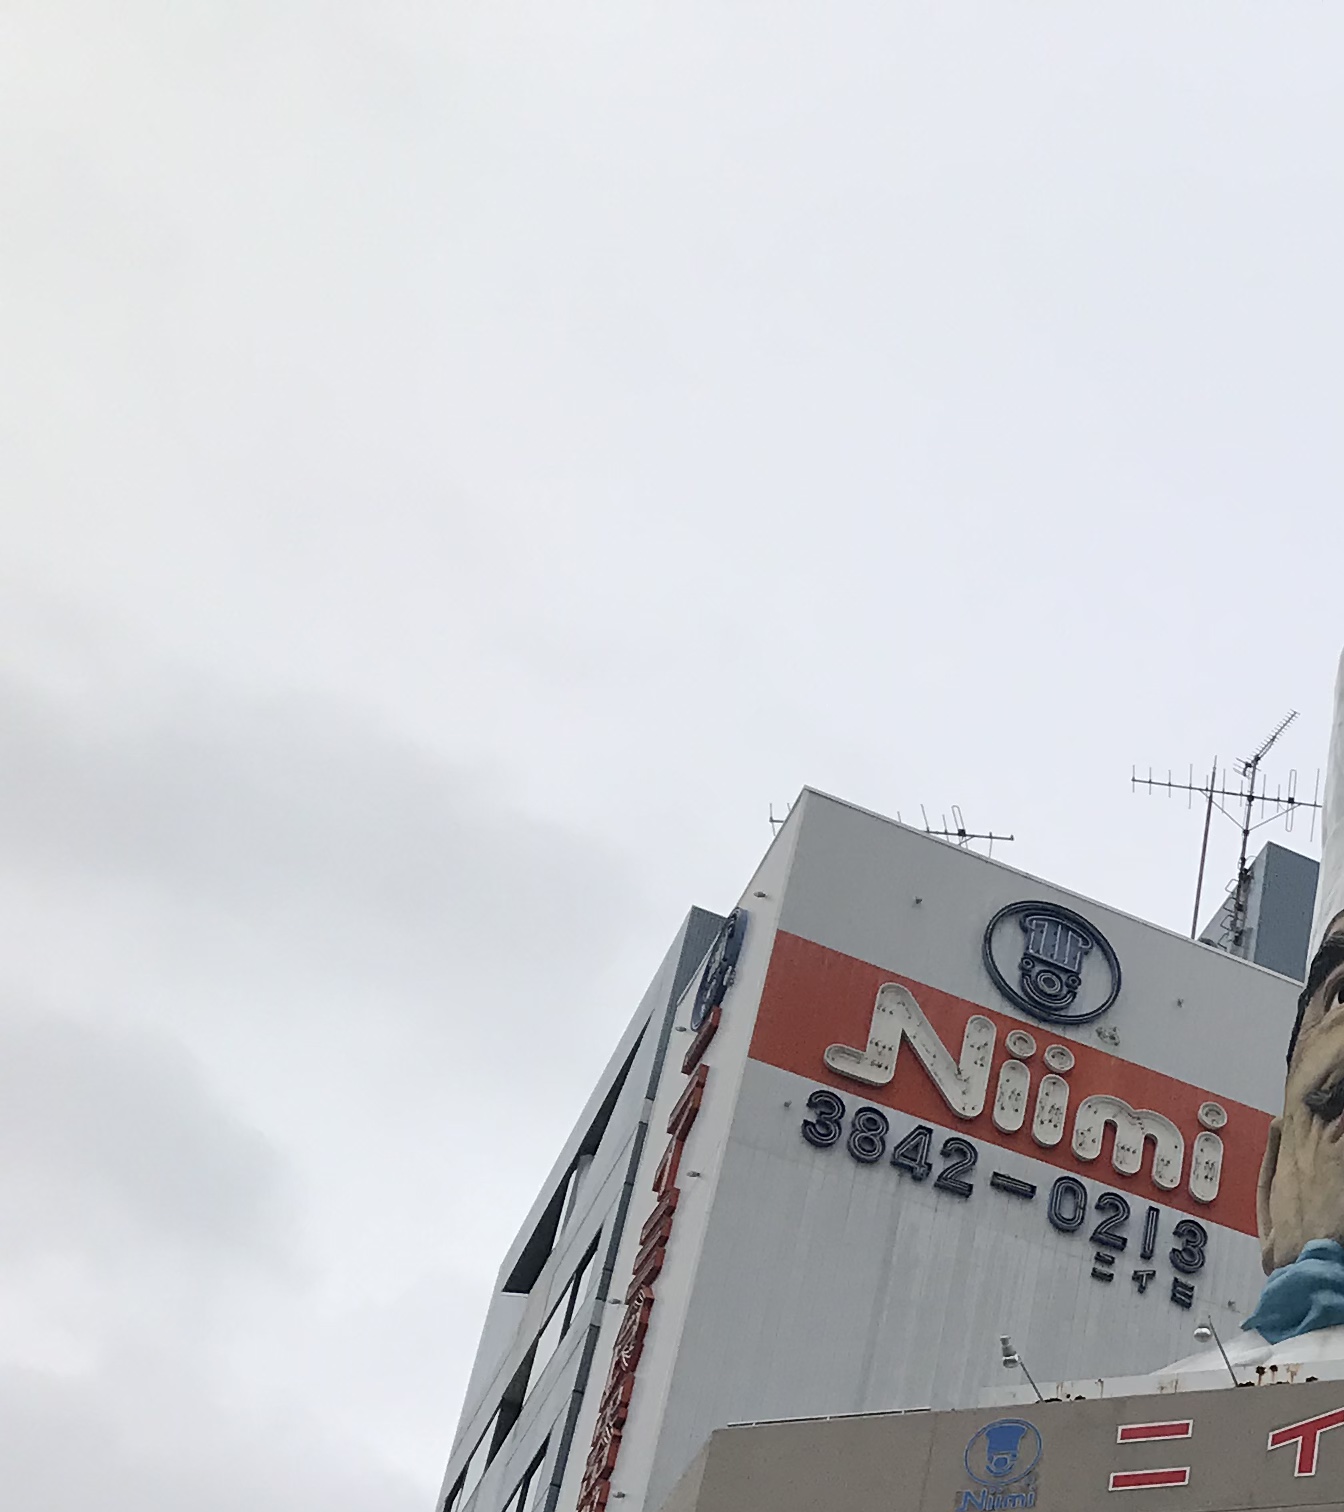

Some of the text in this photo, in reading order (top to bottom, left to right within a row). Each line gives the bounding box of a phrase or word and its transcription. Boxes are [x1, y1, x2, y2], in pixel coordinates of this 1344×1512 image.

[824, 982, 1228, 1203] Niimi
[802, 1090, 1207, 1273] 3842-0213
[1091, 1252, 1195, 1309] ニイミ
[955, 1485, 1035, 1512] Niimi
